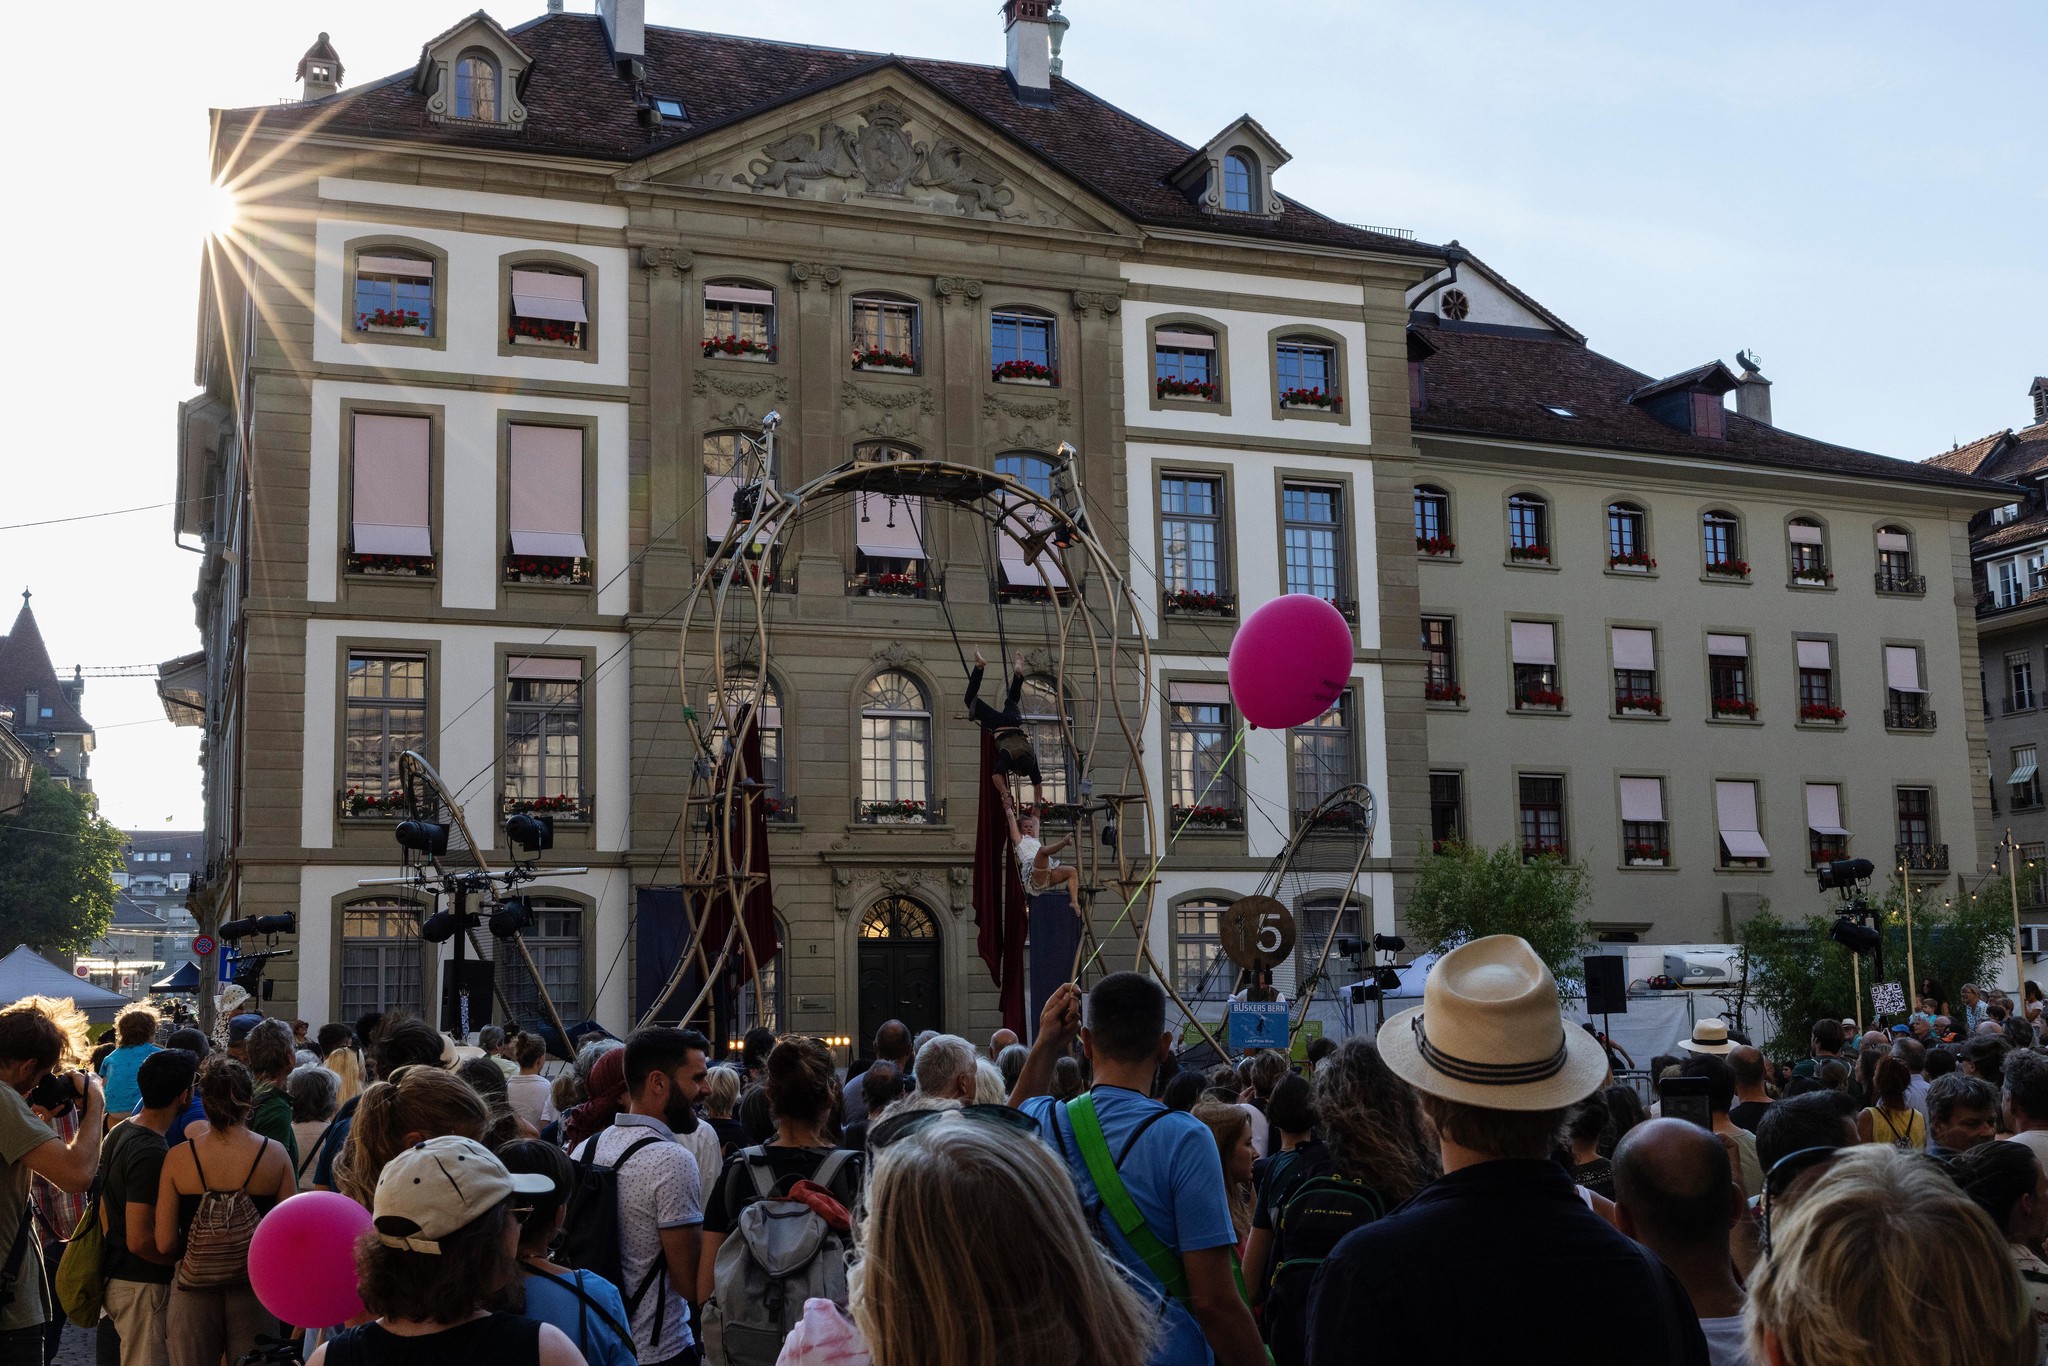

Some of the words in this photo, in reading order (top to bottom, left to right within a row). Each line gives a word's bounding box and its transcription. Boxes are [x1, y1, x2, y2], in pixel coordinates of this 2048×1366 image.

[1235, 912, 1283, 953] 15
[809, 944, 817, 954] 12
[1233, 1003, 1266, 1012] BUSKERS
[1267, 1004, 1286, 1013] BERN
